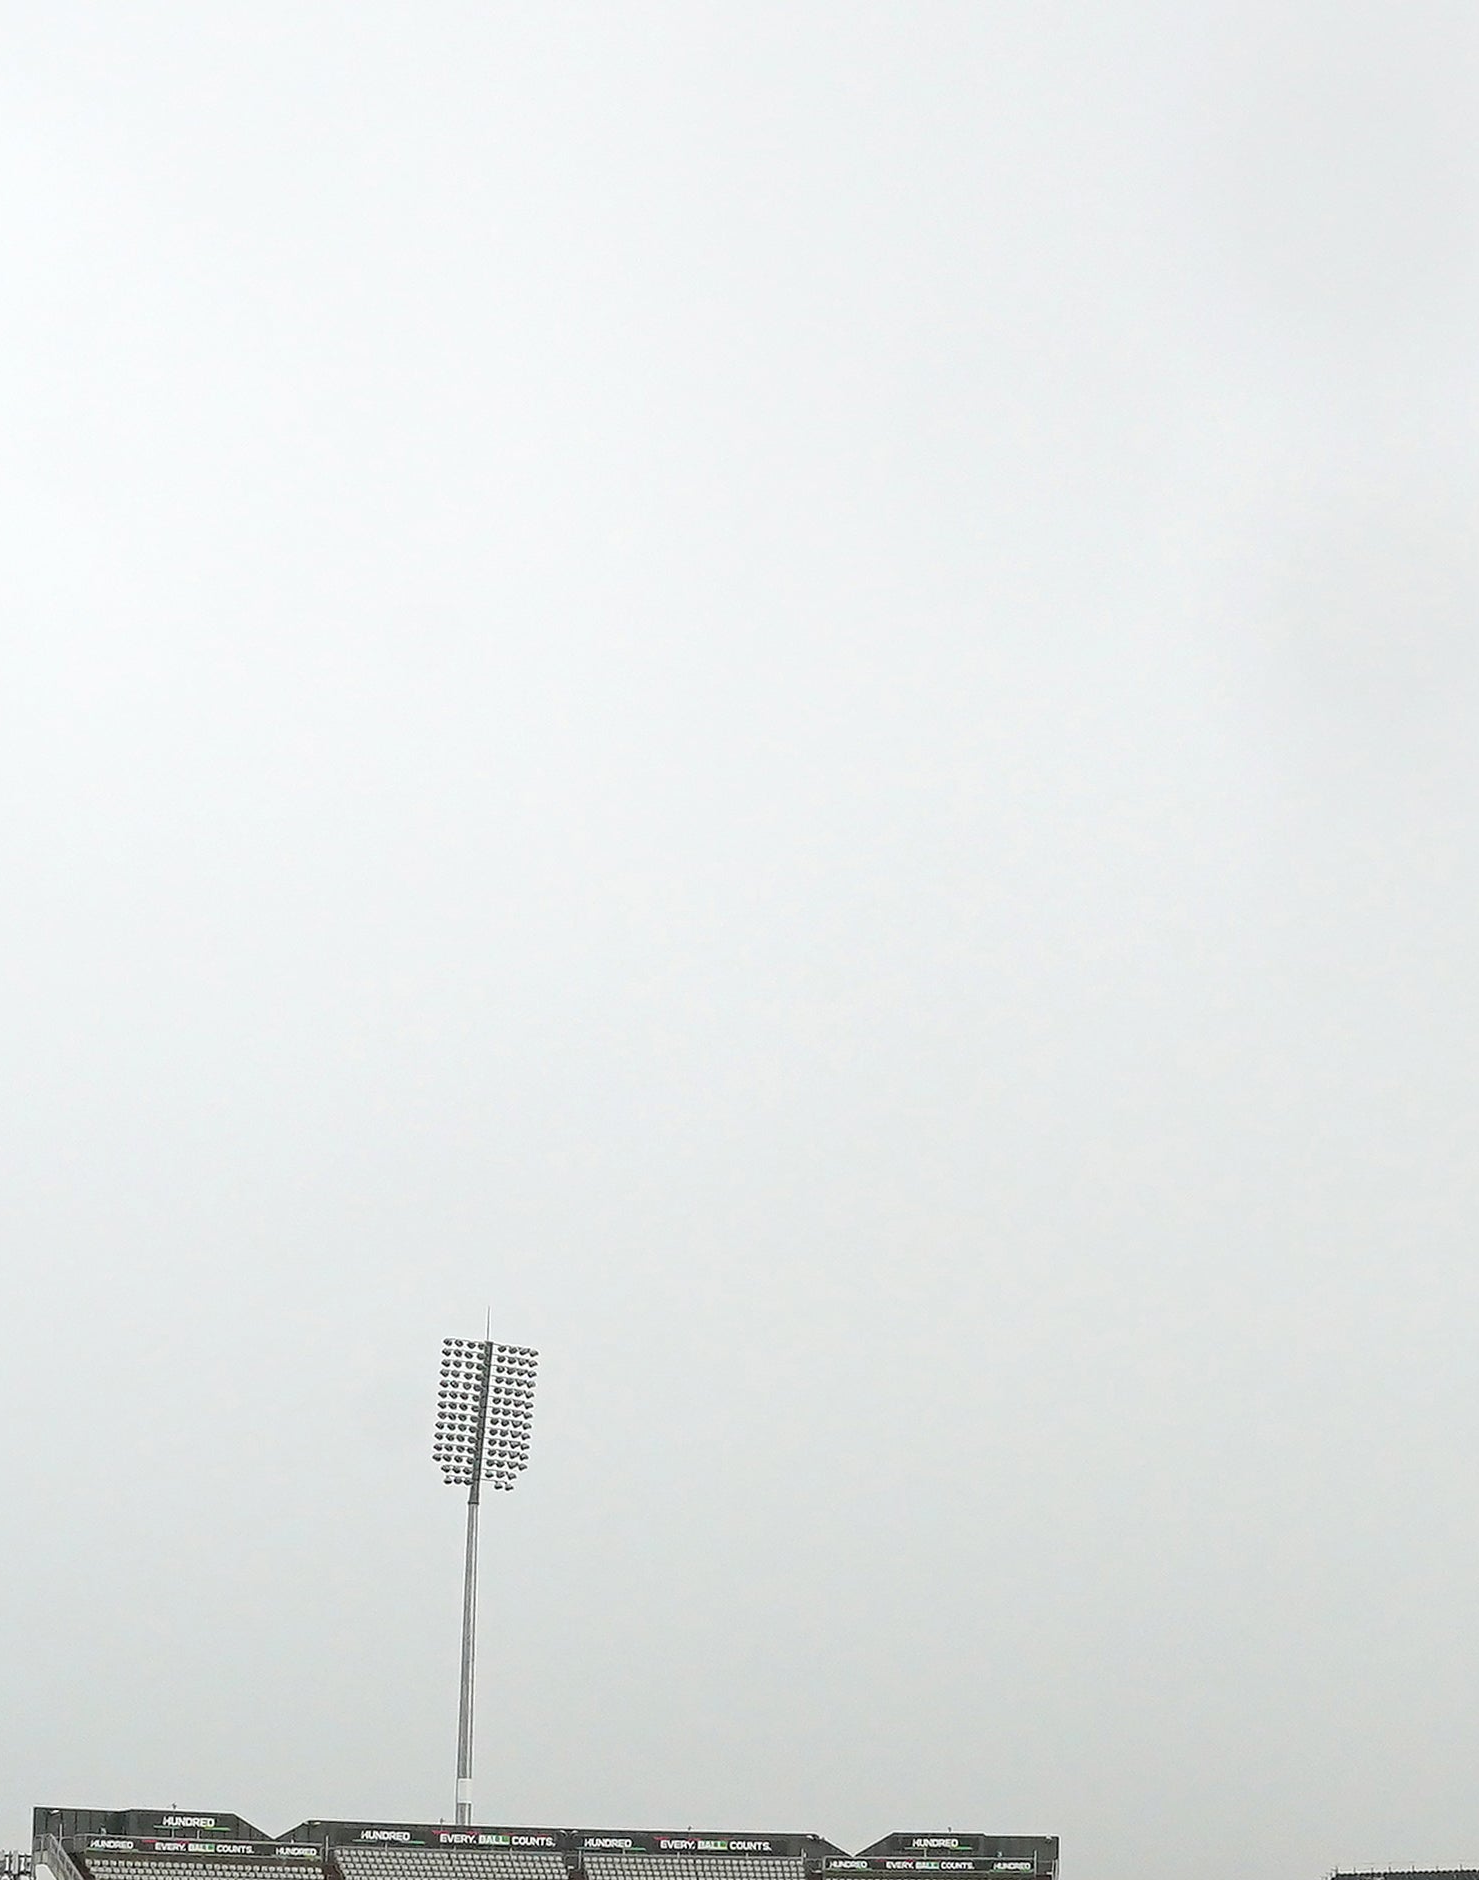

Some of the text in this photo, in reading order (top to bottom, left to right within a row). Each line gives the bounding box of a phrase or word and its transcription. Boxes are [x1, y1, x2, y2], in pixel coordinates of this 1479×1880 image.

[162, 1816, 215, 1828] HUNDRED
[360, 1830, 411, 1842] HUNDRED
[439, 1833, 477, 1845] EVERY.
[511, 1836, 556, 1847] COUNTS.
[154, 1842, 187, 1852] EVERY.
[216, 1844, 255, 1855] COUNTS.
[583, 1838, 633, 1849] HUNDRED
[660, 1839, 696, 1850] EVERY.
[729, 1841, 772, 1851] COUNTS.
